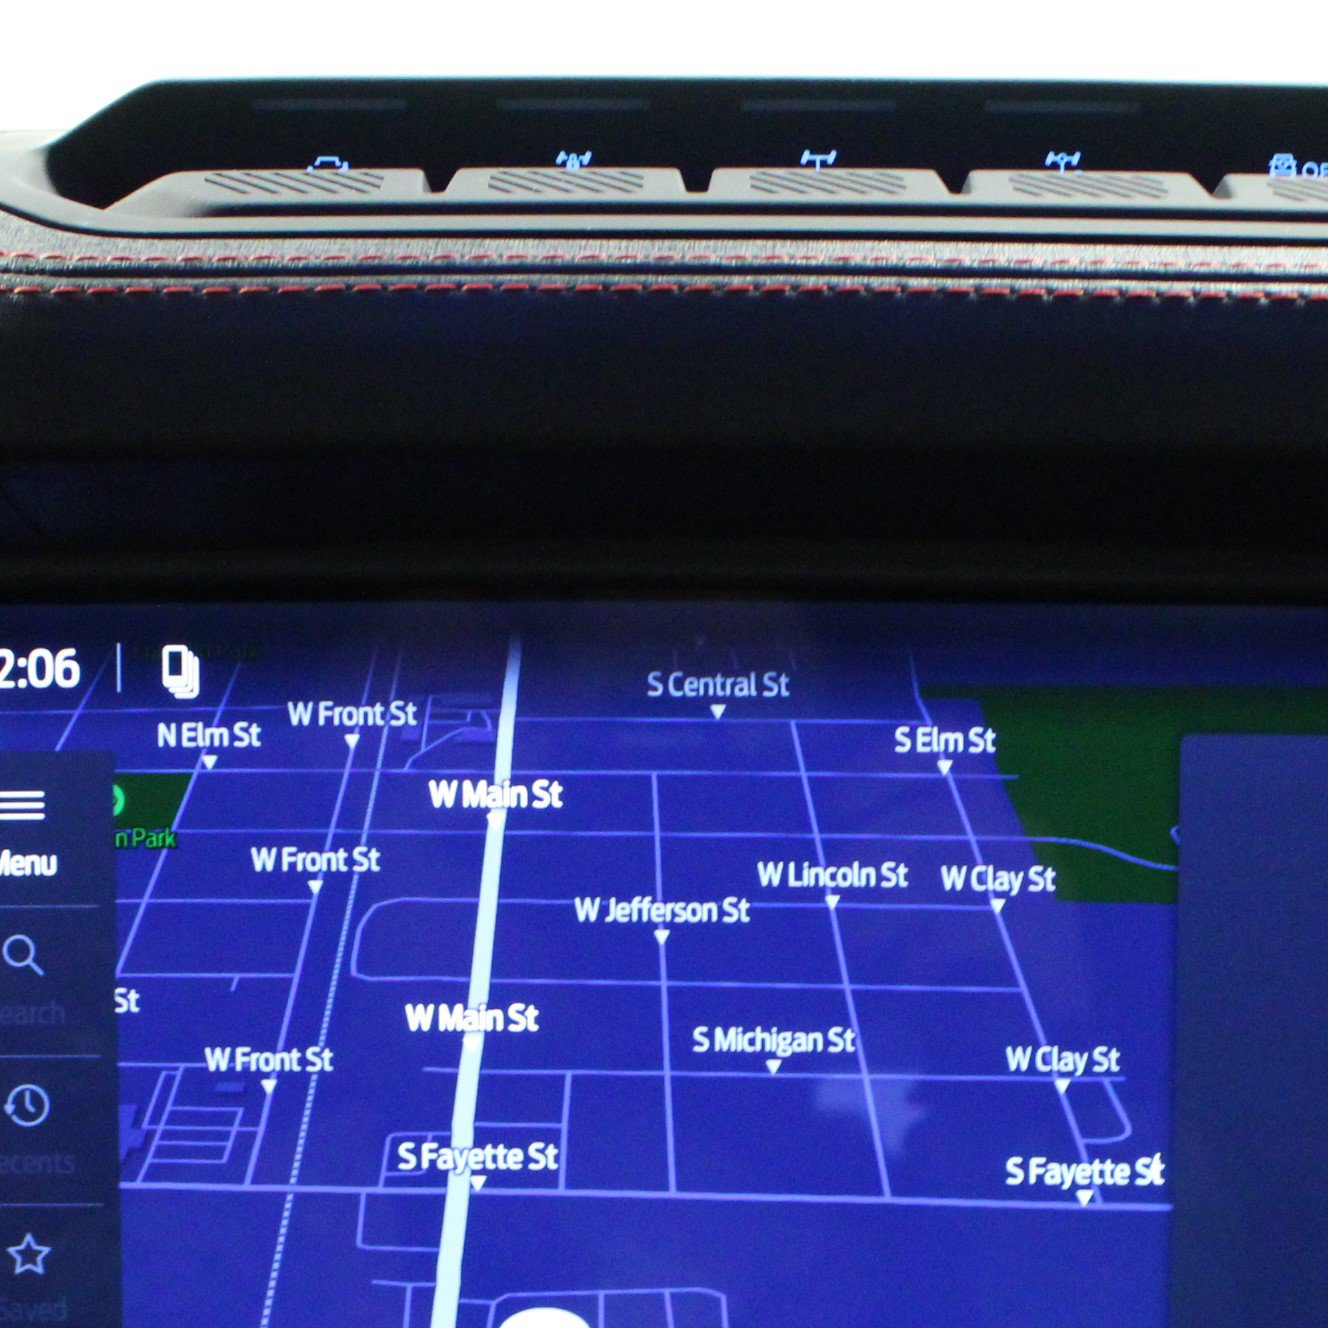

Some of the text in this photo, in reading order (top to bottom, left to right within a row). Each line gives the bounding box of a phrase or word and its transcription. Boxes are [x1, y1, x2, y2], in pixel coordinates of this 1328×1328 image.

[647, 670, 790, 697] S Central St
[287, 701, 417, 726] W Front St
[157, 722, 262, 748] N Elm St
[894, 727, 996, 753] S Elm St
[429, 779, 563, 809] W Main St
[132, 826, 177, 849] Park
[251, 846, 381, 872] W Front St
[757, 860, 908, 888] W Lincoln St
[940, 865, 1056, 897] W Clay St
[574, 896, 750, 924] W Jefferson St
[114, 988, 141, 1013] St
[405, 1003, 539, 1033] W Main St
[692, 1026, 856, 1057] S Michigan St
[204, 1046, 334, 1073] W Front St
[1006, 1046, 1120, 1077] W Clay St
[397, 1143, 559, 1175] S Fayette St
[1005, 1159, 1024, 1186] S
[1028, 1159, 1131, 1191] Fayette
